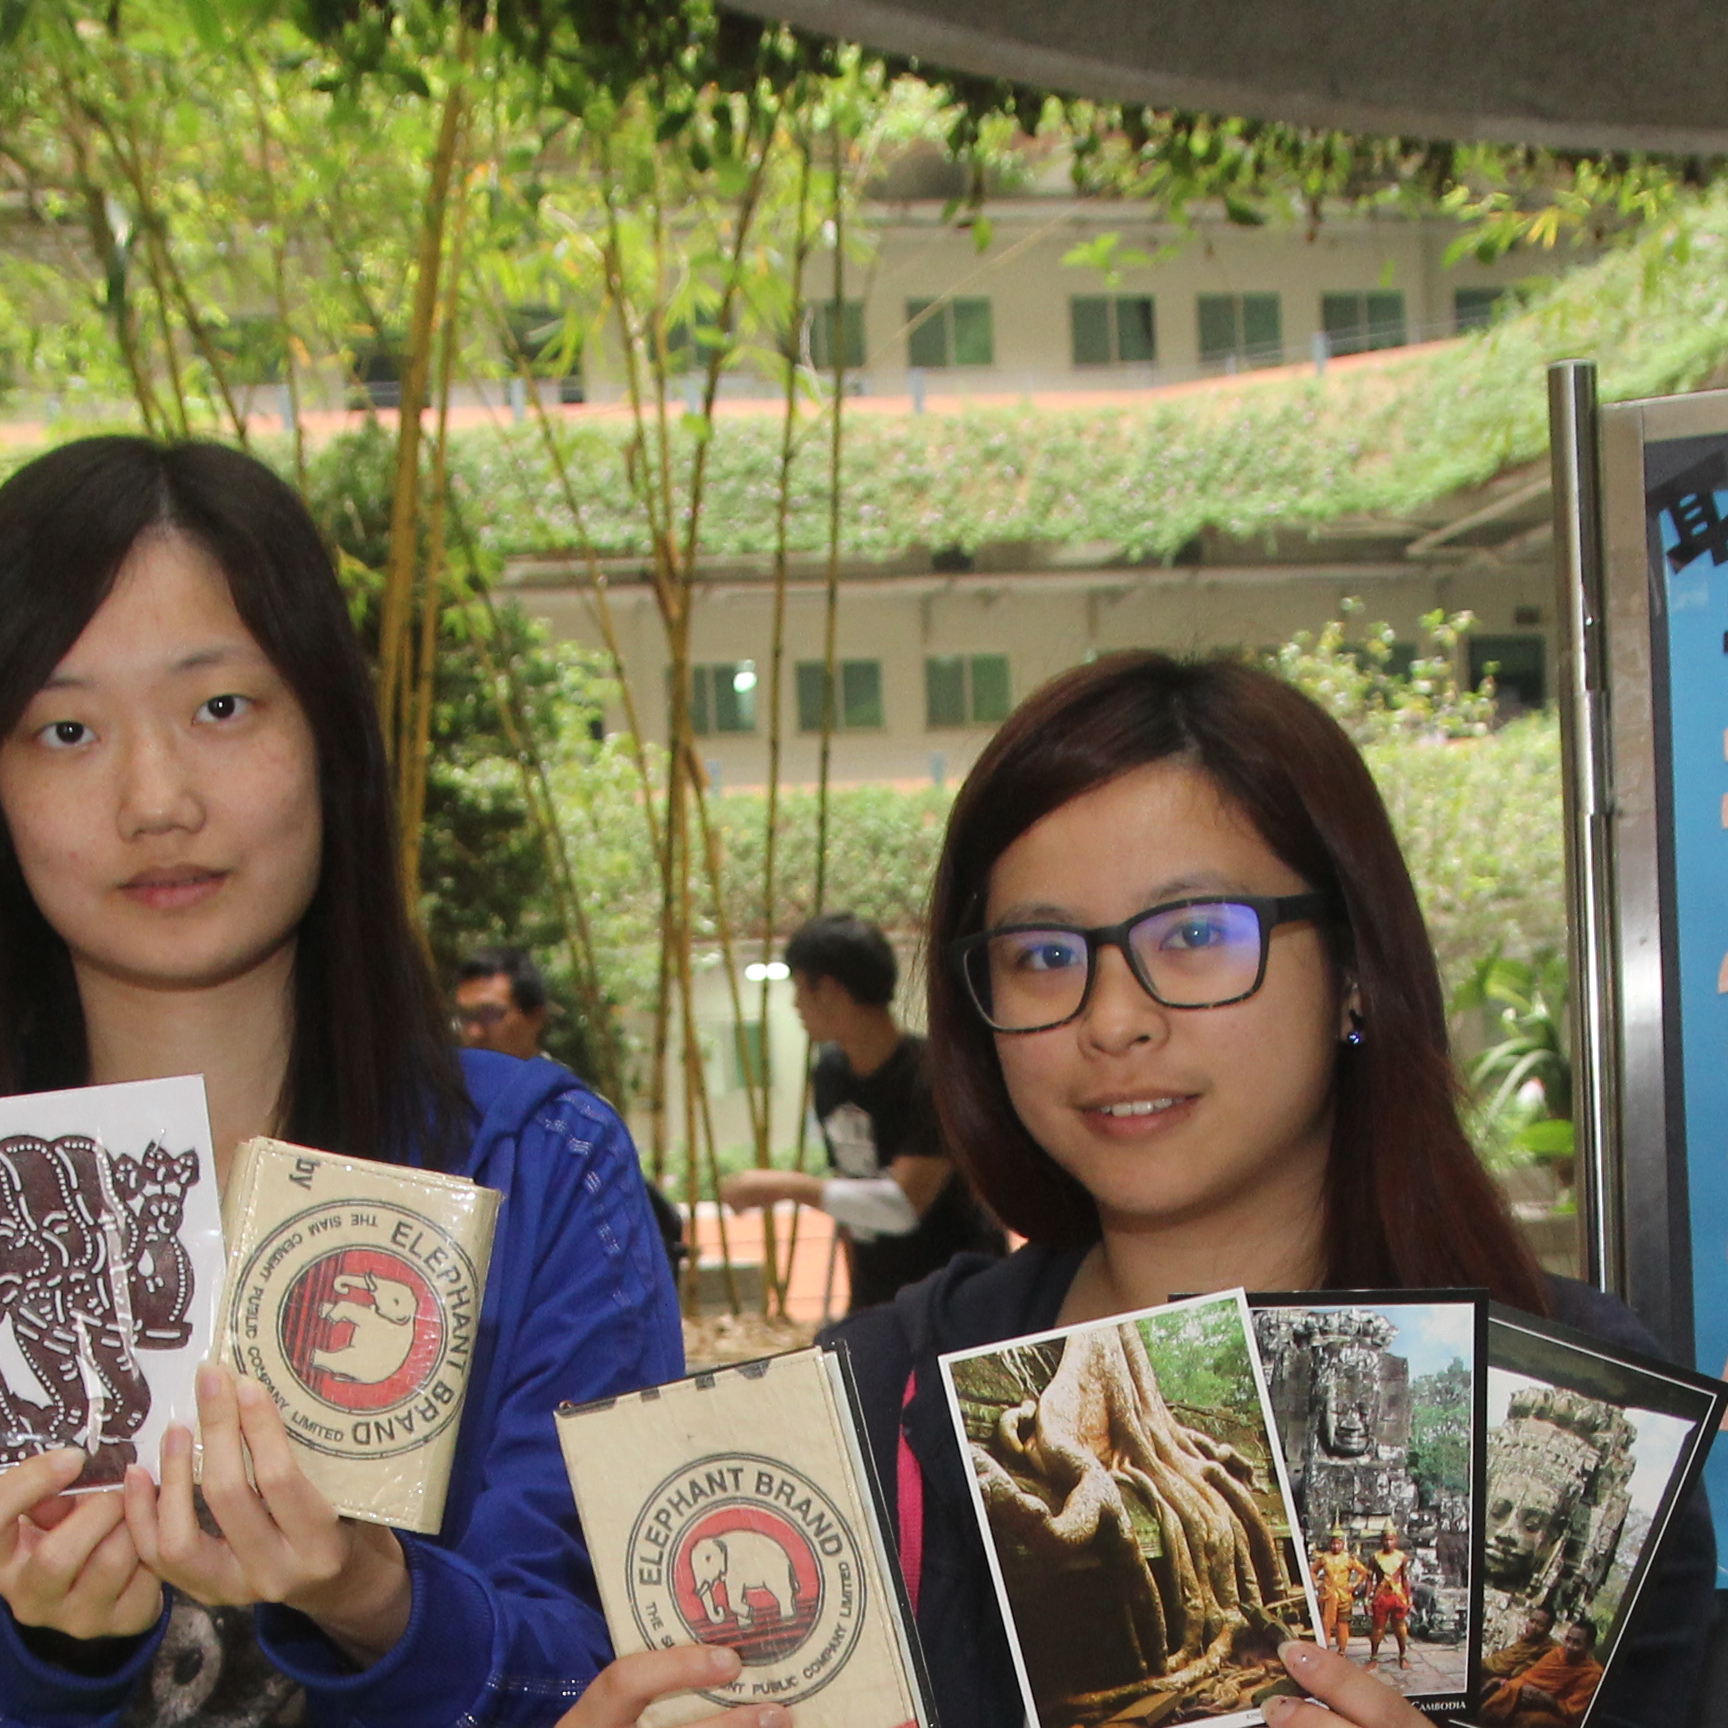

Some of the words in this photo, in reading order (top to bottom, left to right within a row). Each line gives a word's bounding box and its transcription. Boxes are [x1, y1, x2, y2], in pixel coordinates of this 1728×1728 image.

[290, 1157, 320, 1191] by
[308, 1215, 342, 1238] SIAM
[350, 1214, 379, 1227] THE
[260, 1233, 303, 1283] CEMENT
[245, 1286, 265, 1338] PUBLIC
[391, 1220, 472, 1374] ELEPHANT
[247, 1346, 290, 1411] COMPANY
[291, 1411, 344, 1442] LIMITED
[352, 1380, 455, 1446] BRAND
[639, 1467, 745, 1587] ELEPHANT
[754, 1470, 845, 1558] BRAND
[645, 1601, 664, 1632] THE
[752, 1676, 799, 1696] PUBLIC
[802, 1622, 848, 1680] COMPANY
[838, 1561, 855, 1619] LIMITED
